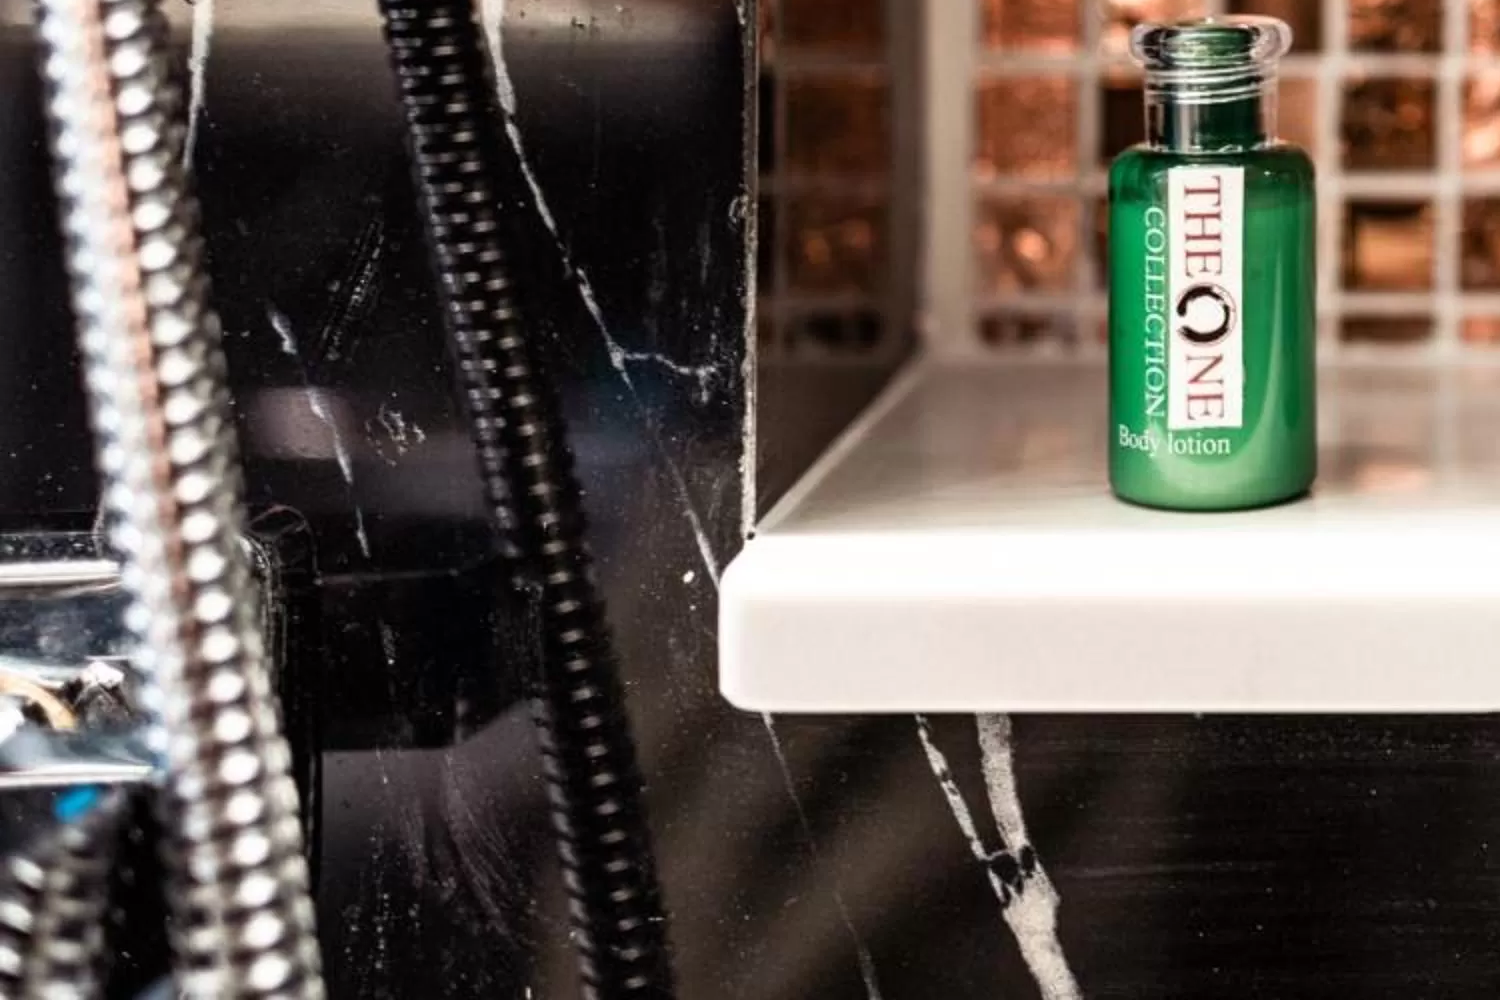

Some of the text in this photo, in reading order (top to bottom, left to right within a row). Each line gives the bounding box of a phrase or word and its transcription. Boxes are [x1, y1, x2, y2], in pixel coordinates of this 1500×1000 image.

[1184, 175, 1222, 278] THE
[1144, 207, 1165, 418] COLLECTION
[1119, 424, 1231, 457] Body lotion
